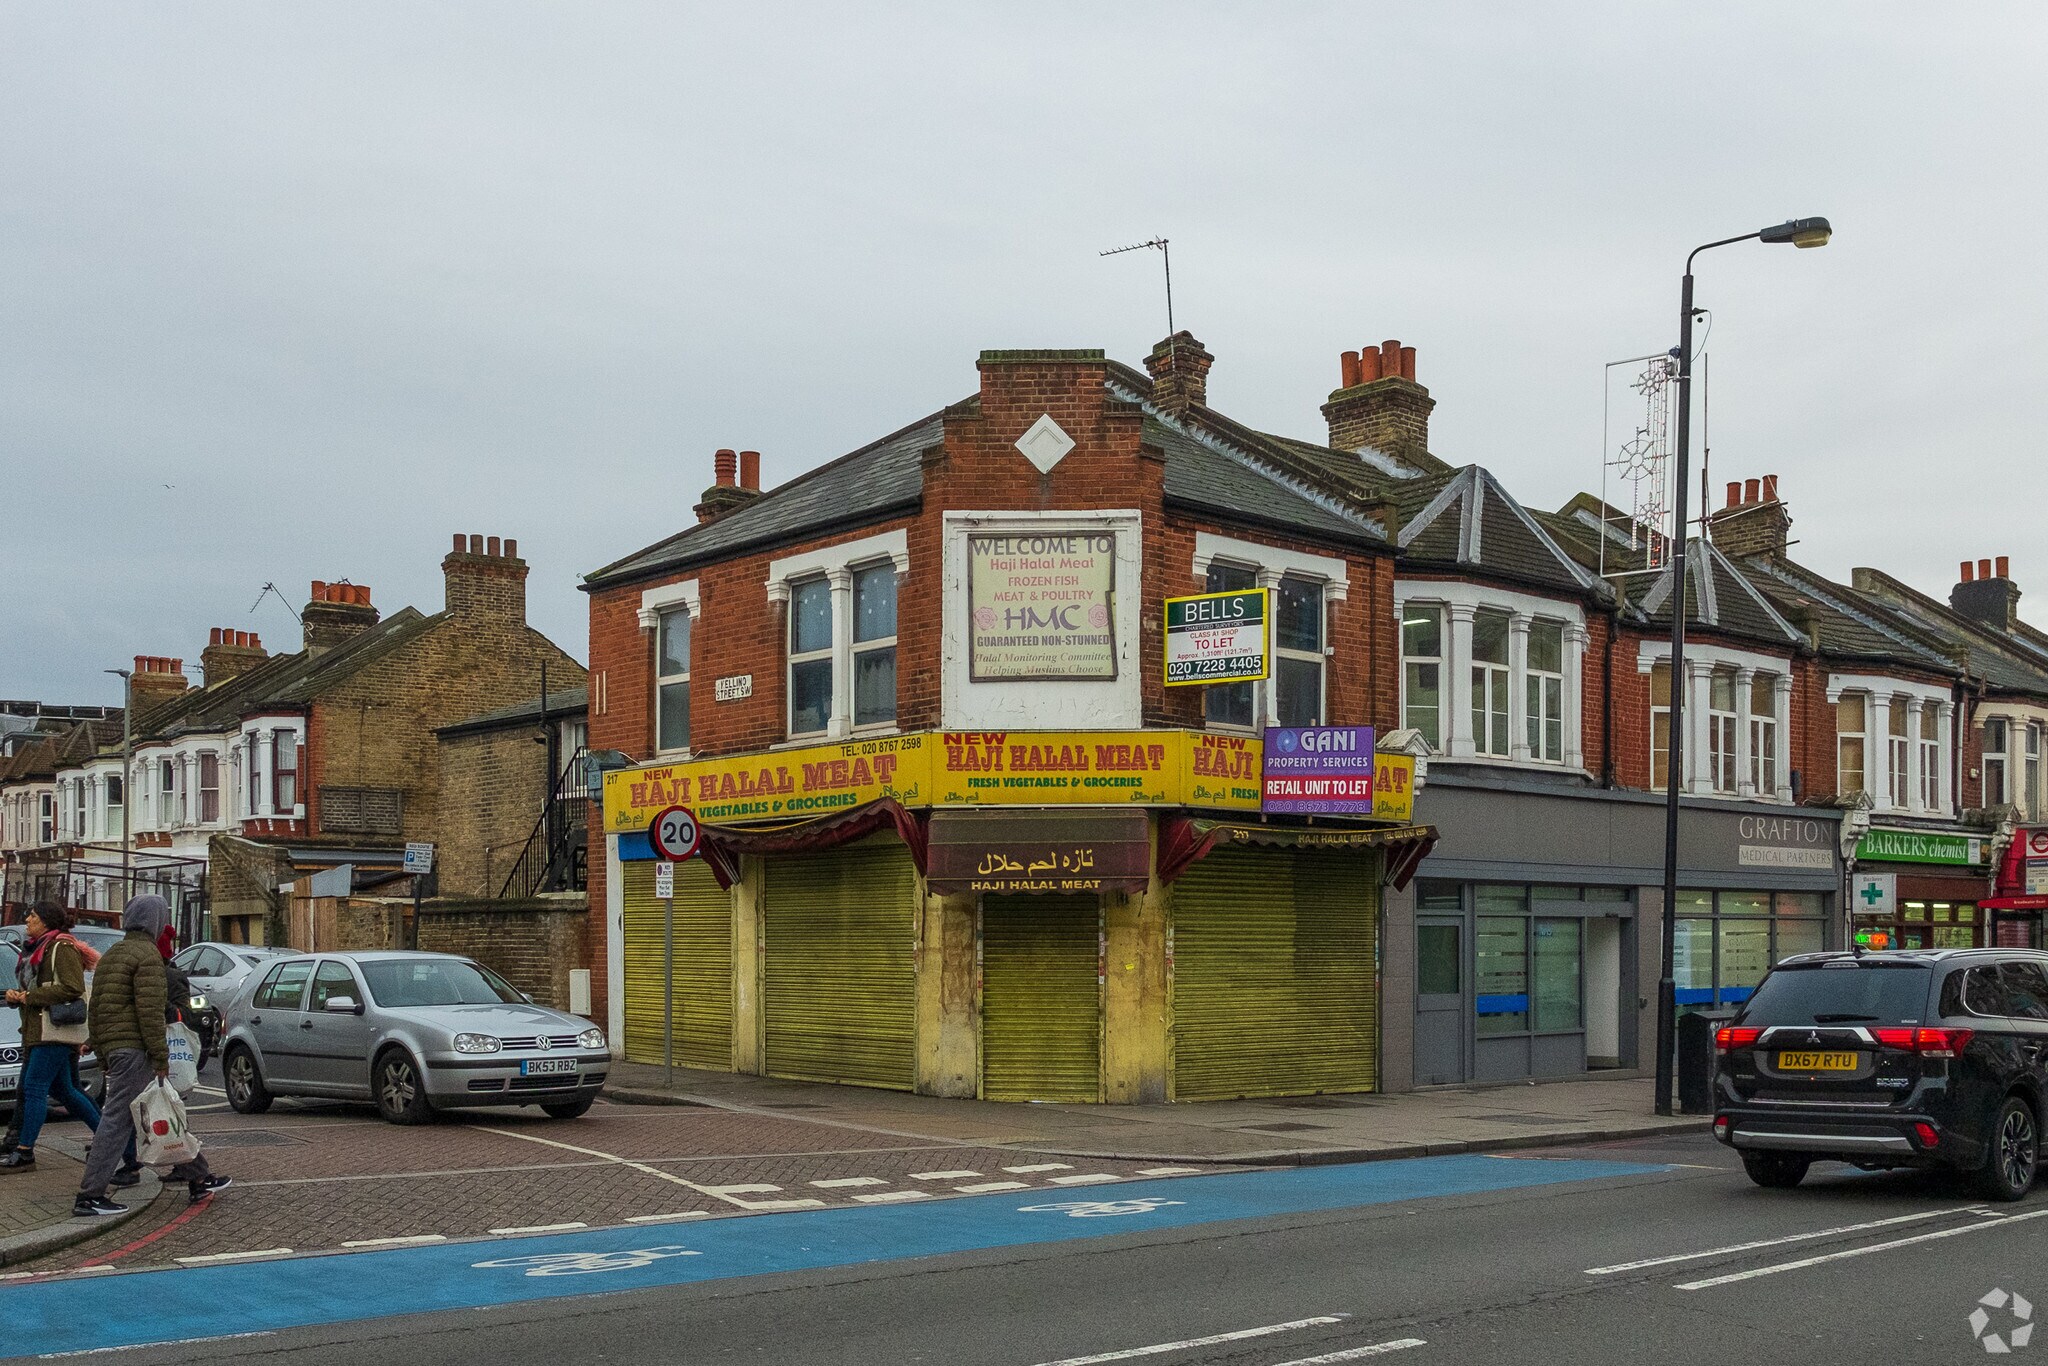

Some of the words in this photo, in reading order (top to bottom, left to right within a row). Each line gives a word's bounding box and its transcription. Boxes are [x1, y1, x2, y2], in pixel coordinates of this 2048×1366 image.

[972, 537, 1077, 556] WELCOME
[1083, 536, 1112, 554] TO
[990, 558, 1016, 572] Haji
[1019, 558, 1055, 570] Halal
[1060, 557, 1094, 569] Meat
[1008, 576, 1052, 586] FROZEN
[1055, 575, 1079, 585] FISH
[994, 592, 1025, 602] MEAT
[1029, 591, 1038, 600] &
[1041, 590, 1094, 600] POULTRY
[1185, 598, 1244, 622] BELLS
[1004, 604, 1081, 631] HMC
[977, 635, 1039, 647] GUARANTEED
[1041, 635, 1110, 646] NON-STUNNED
[1190, 631, 1210, 639] CLASS
[1195, 640, 1210, 650] TO
[1213, 637, 1234, 648] LET
[974, 653, 1000, 663] Halal
[1004, 653, 1057, 663] Monitoring
[1060, 652, 1111, 661] Committee
[984, 666, 1021, 676] Helping
[1025, 665, 1065, 674] Muslims
[1068, 665, 1103, 674] Choose
[1169, 662, 1191, 675] 020
[1195, 659, 1226, 673] 7228
[1229, 656, 1261, 670] 4405
[1168, 668, 1262, 682] www.bellscommercial.co.uk
[943, 733, 1008, 745] NEW
[1202, 735, 1246, 750] NEW
[1301, 730, 1356, 753] GANI
[841, 746, 860, 757] TEL:
[861, 743, 877, 755] 020
[878, 740, 899, 753] 8767
[901, 737, 922, 750] 2598
[946, 745, 1004, 772] HAJI
[1009, 745, 1089, 771] HALAL
[1095, 744, 1164, 771] MEAT
[1193, 747, 1254, 780] HAJI
[1268, 757, 1319, 768] PROPERTY
[1323, 757, 1368, 767] SERVICES
[607, 774, 618, 785] 217
[630, 778, 691, 808] HAJI
[698, 766, 795, 801] HALAL
[802, 754, 897, 791] MEAT
[644, 768, 673, 781] NEW
[1374, 765, 1408, 794] AT
[968, 777, 1000, 788] FRESH
[1003, 777, 1068, 788] VEGETABLES
[1071, 778, 1080, 787] &
[1084, 777, 1142, 787] GROCERIES
[1267, 780, 1302, 794] RETAIL
[1305, 780, 1330, 794] UNIT
[1332, 780, 1347, 794] TO
[1349, 780, 1368, 794] LET
[1231, 787, 1259, 800] FRESH
[699, 802, 768, 818] VEGETABLES
[772, 800, 783, 812] &
[787, 793, 857, 810] GROCERIES
[1268, 801, 1292, 812] 020
[663, 822, 694, 844] 20
[1740, 816, 1832, 843] GRAFTON
[1298, 835, 1319, 844] HAJI
[1321, 834, 1349, 843] HALAL
[1351, 833, 1372, 843] MEAT
[1866, 833, 1927, 856] BARKERS
[1929, 838, 1968, 859] chemist
[978, 852, 1024, 875] حلال
[1027, 851, 1057, 877] لحم
[1741, 849, 1781, 862] MEDICAL
[1787, 852, 1831, 865] PARTNERS
[971, 881, 1004, 890] HAJI
[1009, 881, 1057, 890] HALAL
[1061, 880, 1101, 889] MEAT
[169, 1052, 194, 1062] aste
[1784, 1054, 1820, 1067] DX67
[1823, 1054, 1852, 1067] RTU
[528, 1061, 555, 1073] BK53
[558, 1060, 576, 1071] RBZ
[163, 1142, 183, 1151] Iceland
